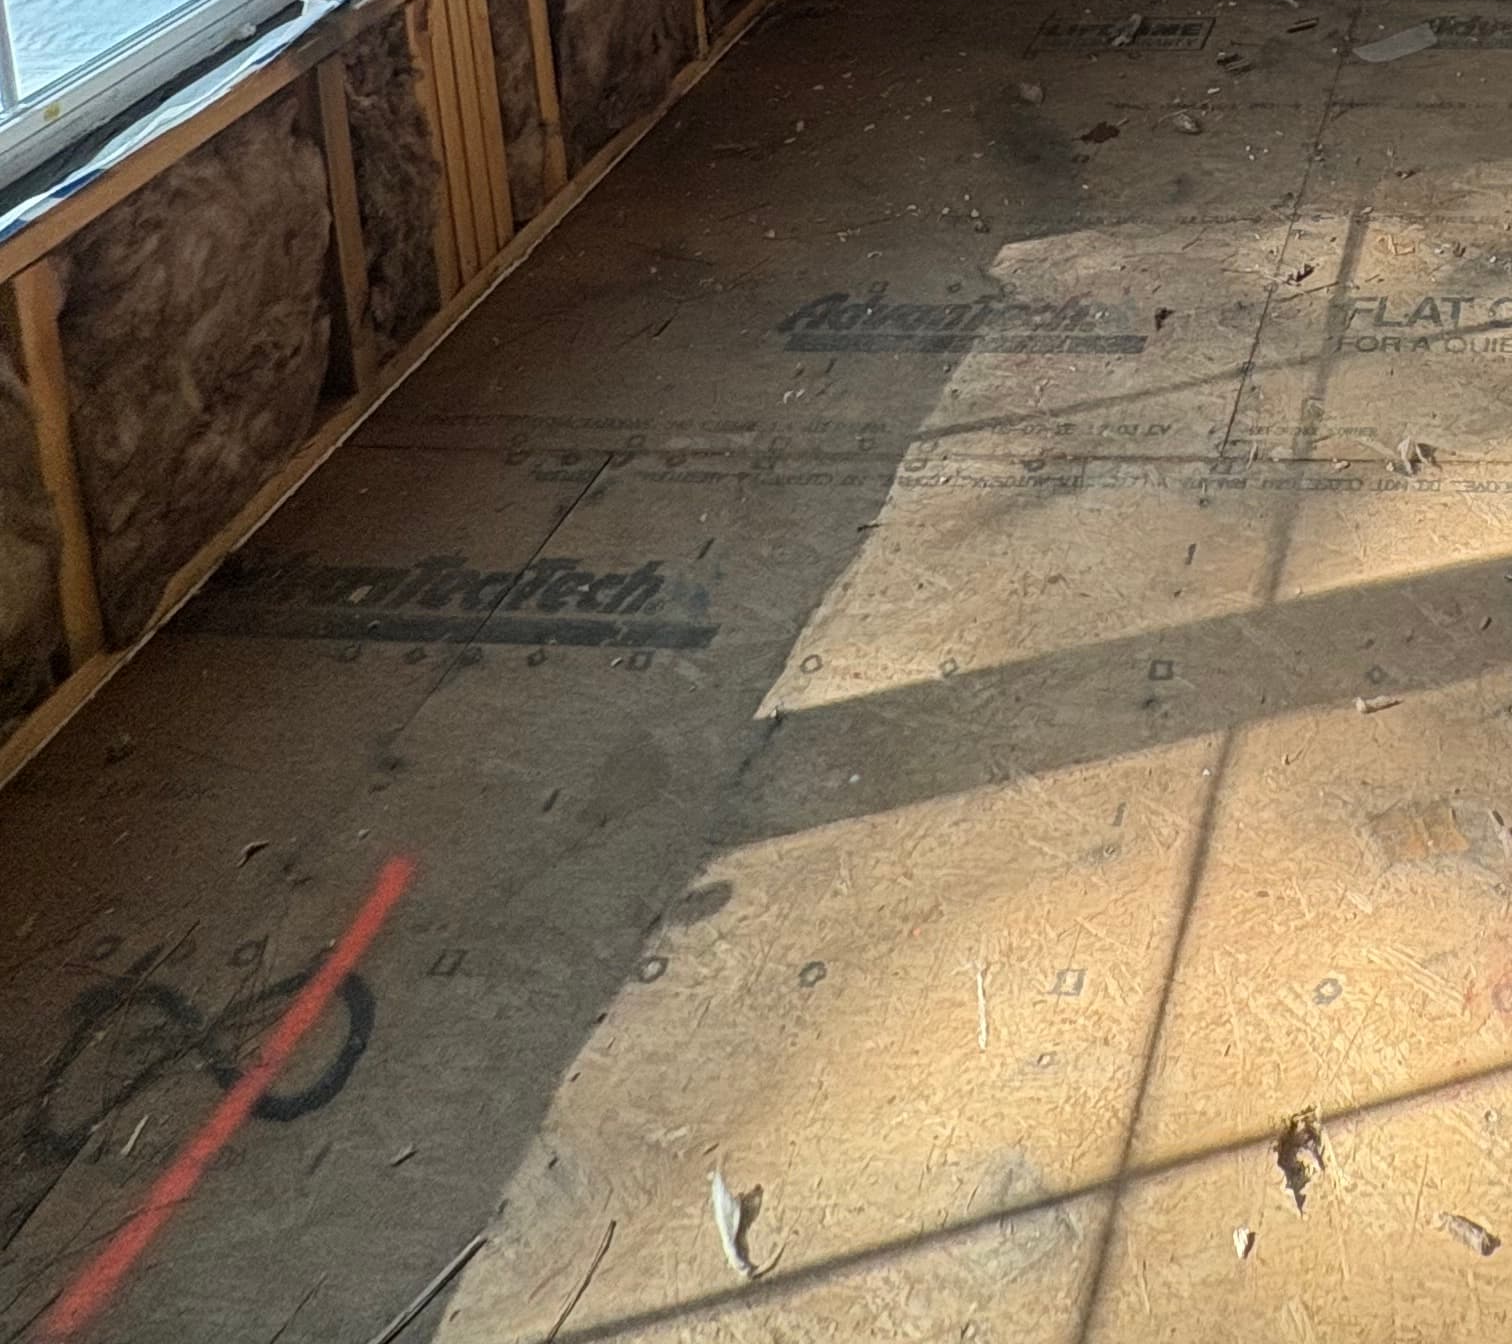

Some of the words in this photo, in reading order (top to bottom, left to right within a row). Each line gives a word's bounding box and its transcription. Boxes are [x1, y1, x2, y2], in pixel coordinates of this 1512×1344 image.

[1343, 296, 1474, 329] FLAT
[1335, 336, 1400, 353] FOR
[1411, 337, 1431, 353] A
